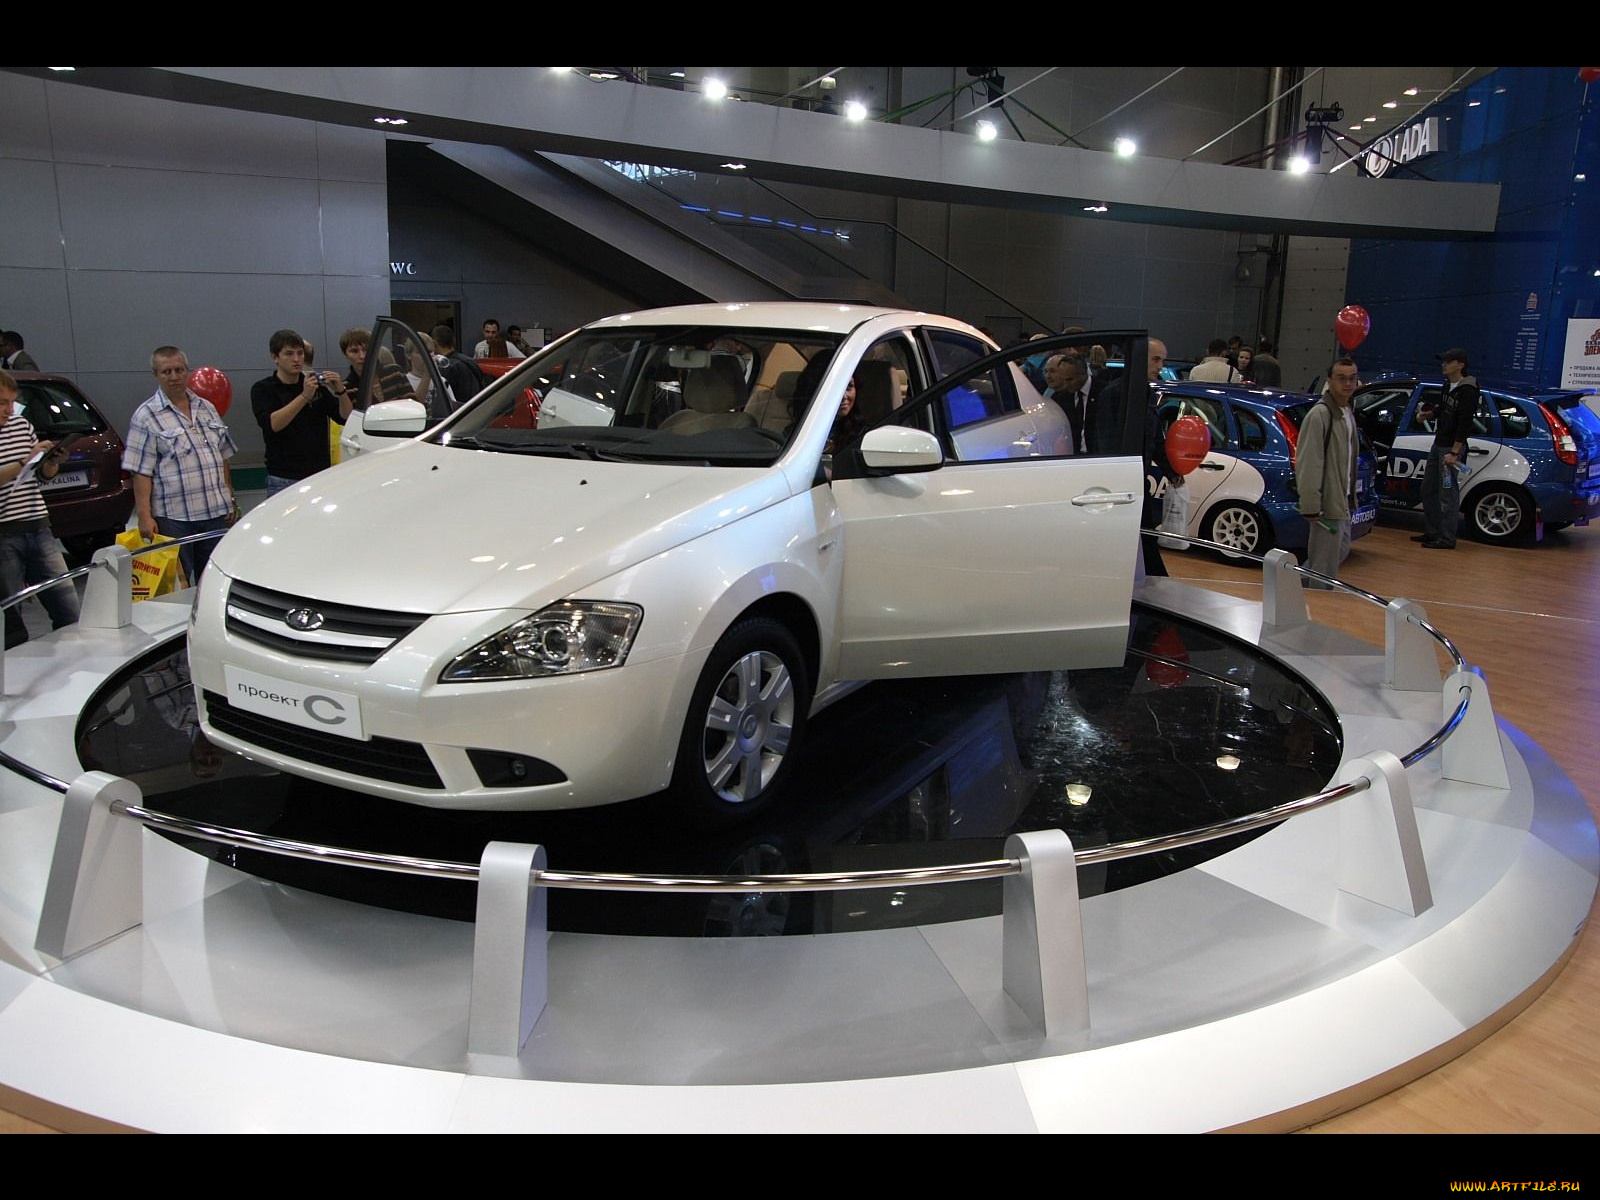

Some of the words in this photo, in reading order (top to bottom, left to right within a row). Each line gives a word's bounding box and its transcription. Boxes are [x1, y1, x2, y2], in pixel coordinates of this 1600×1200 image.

[1394, 117, 1438, 167] LADA
[389, 262, 417, 275] WC
[52, 475, 80, 485] KALINA
[238, 682, 300, 708] проект
